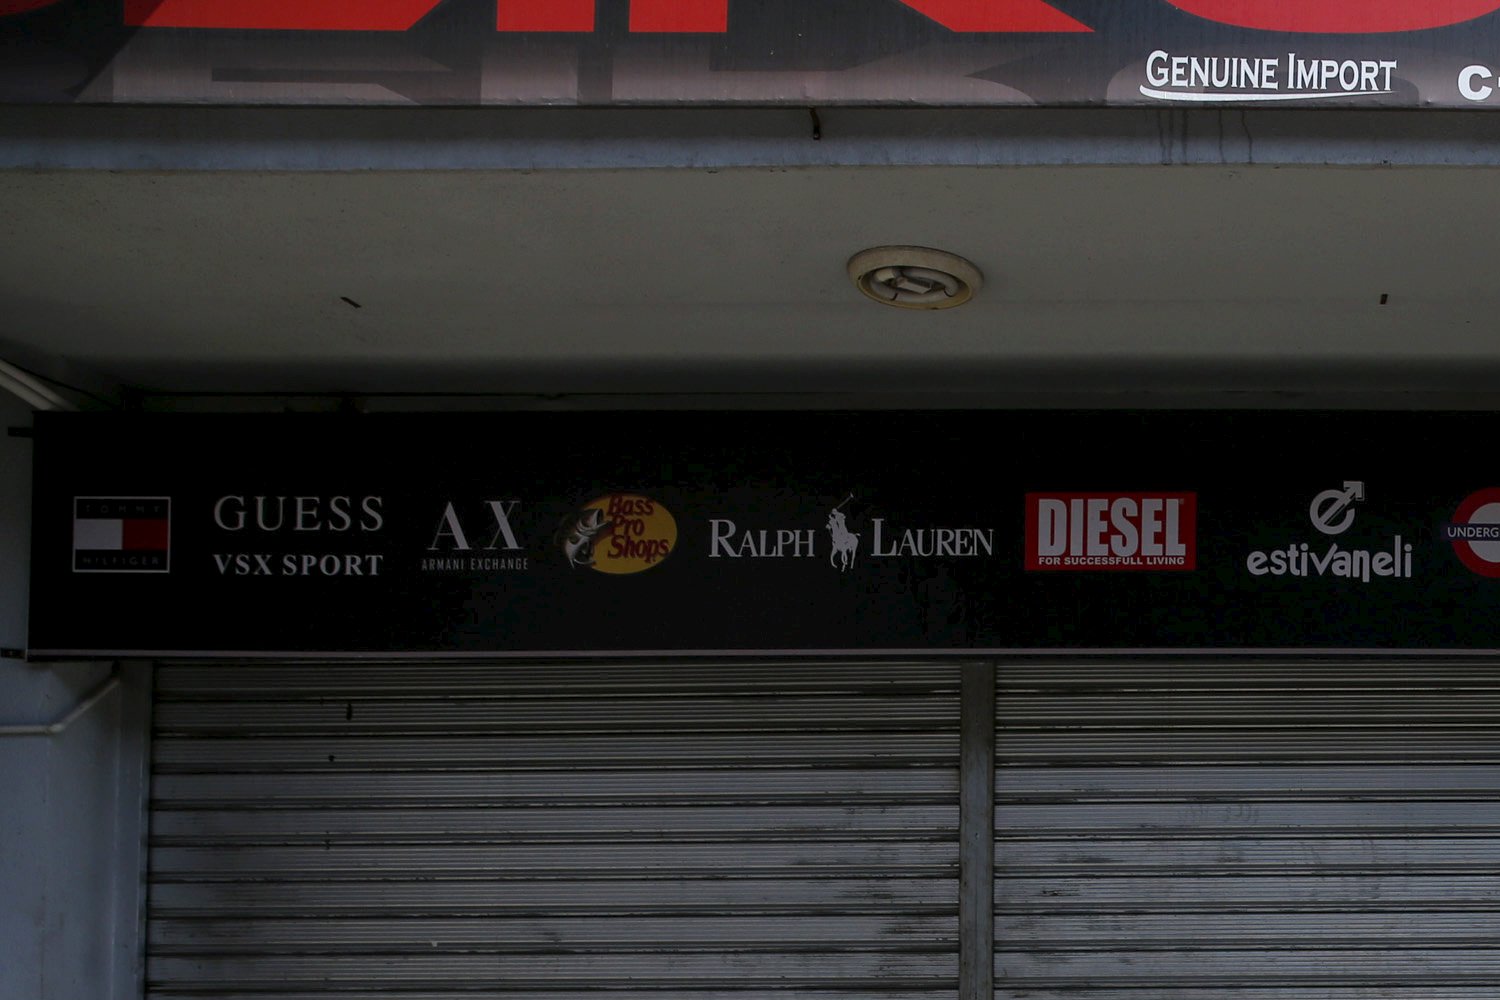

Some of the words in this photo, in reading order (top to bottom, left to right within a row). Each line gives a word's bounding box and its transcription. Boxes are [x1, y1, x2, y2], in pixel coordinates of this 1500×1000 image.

[1145, 49, 1279, 90] GENUINE
[1287, 52, 1397, 91] IMPORT
[212, 494, 384, 532] GUESS
[606, 495, 654, 516] Bass
[611, 514, 645, 536] Pro
[708, 518, 815, 558] RALPH
[871, 517, 995, 558] LAUREN
[1038, 497, 1187, 557] DIESEL
[608, 534, 670, 563] Shops
[1038, 557, 1062, 566] FOR
[1064, 557, 1144, 566] SUCCESSFULL
[1146, 557, 1185, 566] LIVING
[212, 554, 273, 576] VSX
[282, 553, 384, 577] SPORT
[421, 558, 465, 571] ARMANI
[470, 557, 529, 571] EXCHANGE
